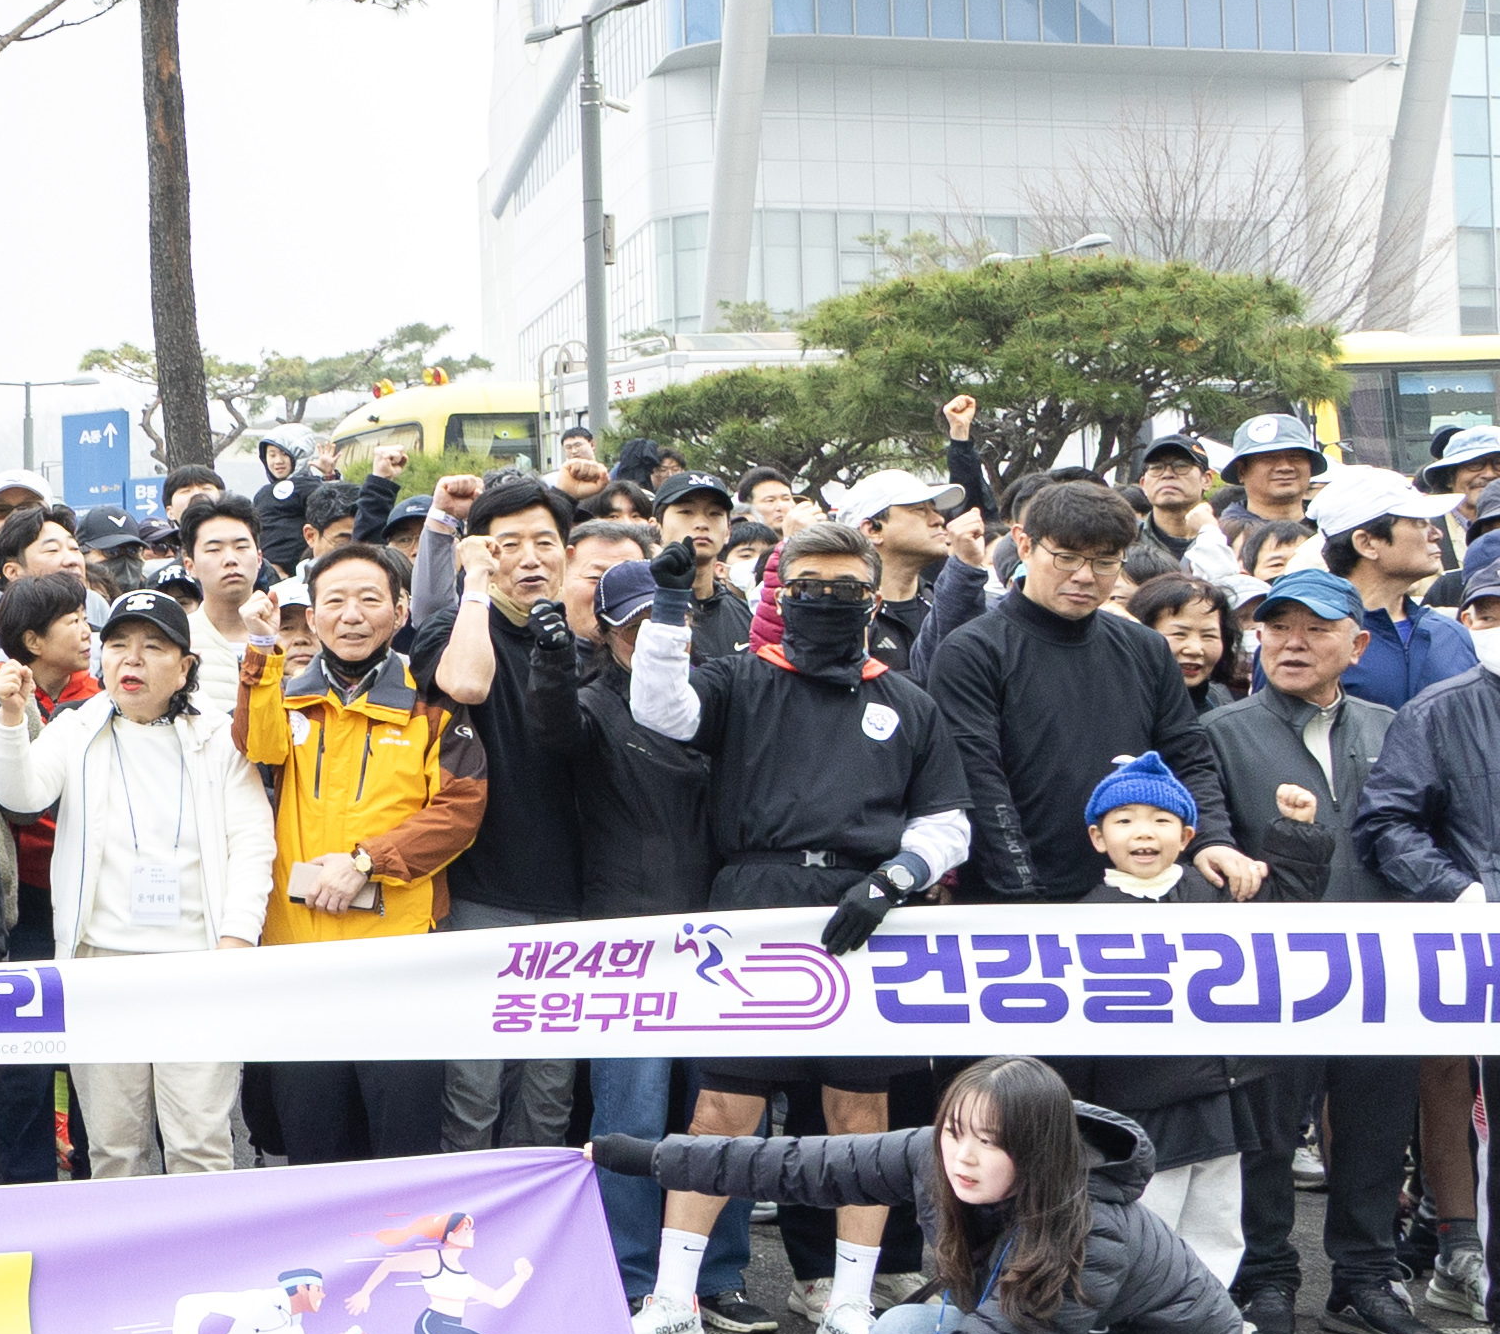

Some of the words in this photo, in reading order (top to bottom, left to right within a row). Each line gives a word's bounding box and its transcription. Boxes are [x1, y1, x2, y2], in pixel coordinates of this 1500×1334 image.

[497, 938, 656, 980] 제24회
[867, 932, 1386, 1024] 건강달리기
[492, 992, 678, 1033] 중원구민
[23, 1041, 67, 1056] 2000
